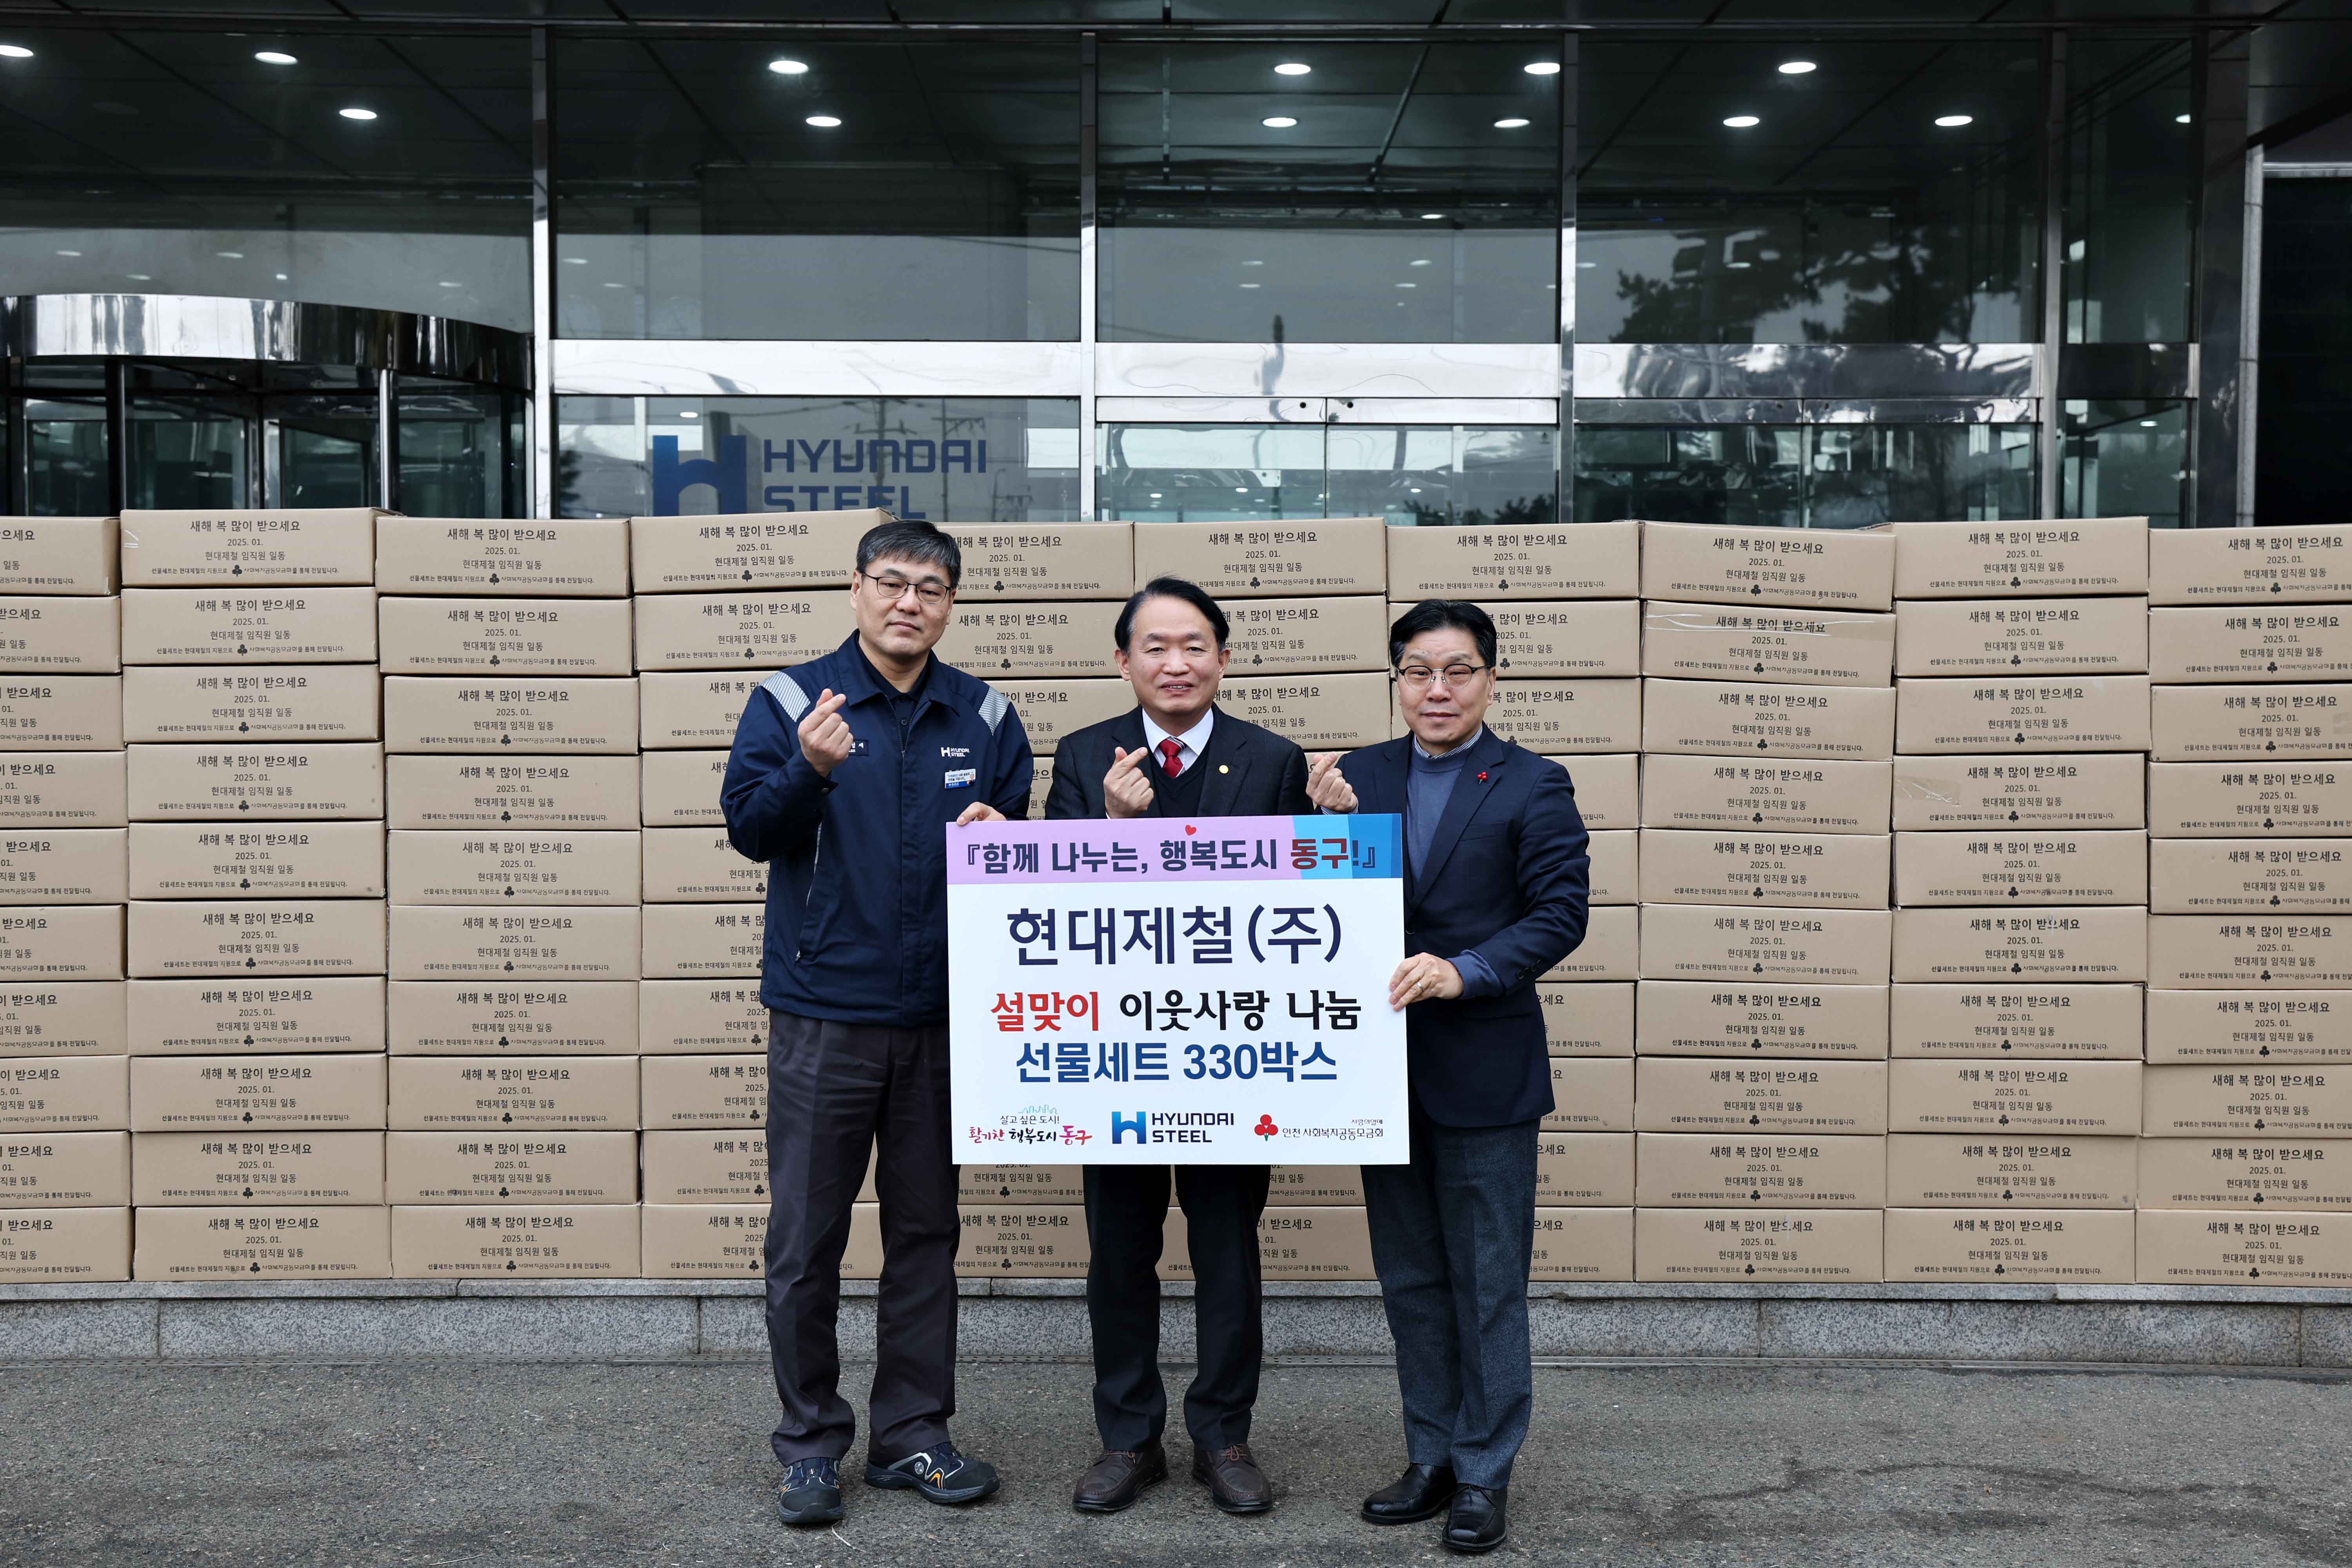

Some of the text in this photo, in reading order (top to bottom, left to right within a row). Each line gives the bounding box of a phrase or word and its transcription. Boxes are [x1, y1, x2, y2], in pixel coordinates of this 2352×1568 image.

[764, 439, 987, 473] HYUNDAI
[764, 485, 926, 519] STEEL
[190, 520, 301, 532] 새해 복 많이 받으세요
[699, 524, 809, 539] 새해 복 많이 받으세요
[1208, 531, 1318, 545] 새해 복 많이 받으세요
[1457, 534, 1567, 547] 새해 복 많이 받으세요
[2228, 536, 2343, 551] 새해 복 많이 받으세요
[205, 551, 286, 561] 현대제철 임직원 일동
[1494, 553, 1515, 561] 2025.
[2267, 555, 2289, 564] 2025.
[1472, 565, 1552, 576] 현대제철 임직원 일동
[2243, 568, 2327, 579] 현대제철 임직원 일동
[457, 690, 569, 702] 새해 복 많이 받으세요
[1973, 688, 2084, 701] 새해 복 많이 받으세요
[1713, 842, 1824, 857] 새해 복 많이 받으세요
[1967, 842, 2077, 855] 새해 복 많이 받으세요
[967, 838, 1375, 874] 『함께 나누는, 행복도시 동구!』
[2228, 850, 2342, 863] 새해 복 많이 받으세요
[2004, 860, 2025, 868] 2025.
[1982, 873, 2062, 883] 현대제철 임직원 일동
[1007, 903, 1341, 965] 현대제철(주)
[990, 989, 1361, 1032] 설맞이 이웃사랑 나눔
[1016, 1041, 1337, 1083] 선물세트 330박스
[1709, 1070, 1819, 1083] 새해 복 많이 받으세요
[1746, 1089, 1768, 1097] 2025.
[1723, 1101, 1803, 1112] 현대제철 임직원 일동
[1000, 1115, 1059, 1125] 살고 싶은 도시!
[1152, 1112, 1234, 1126] HYUNDAI
[969, 1125, 1093, 1145] 활기찬 행복도시 동구
[1152, 1130, 1212, 1143] STEEL
[1282, 1128, 1383, 1141] 인천 사회복지공동모금회
[457, 1143, 567, 1155] 새해 복 많이 받으세요
[472, 1173, 552, 1183] 현대제철 임직원 일동
[208, 1217, 319, 1230] 새해 복 많이 받으세요
[2207, 1222, 2320, 1236] 새해 복 많이 받으세요
[2245, 1241, 2282, 1250] 2025. 01.
[2222, 1253, 2304, 1265] 현대제철 임직원 일동
